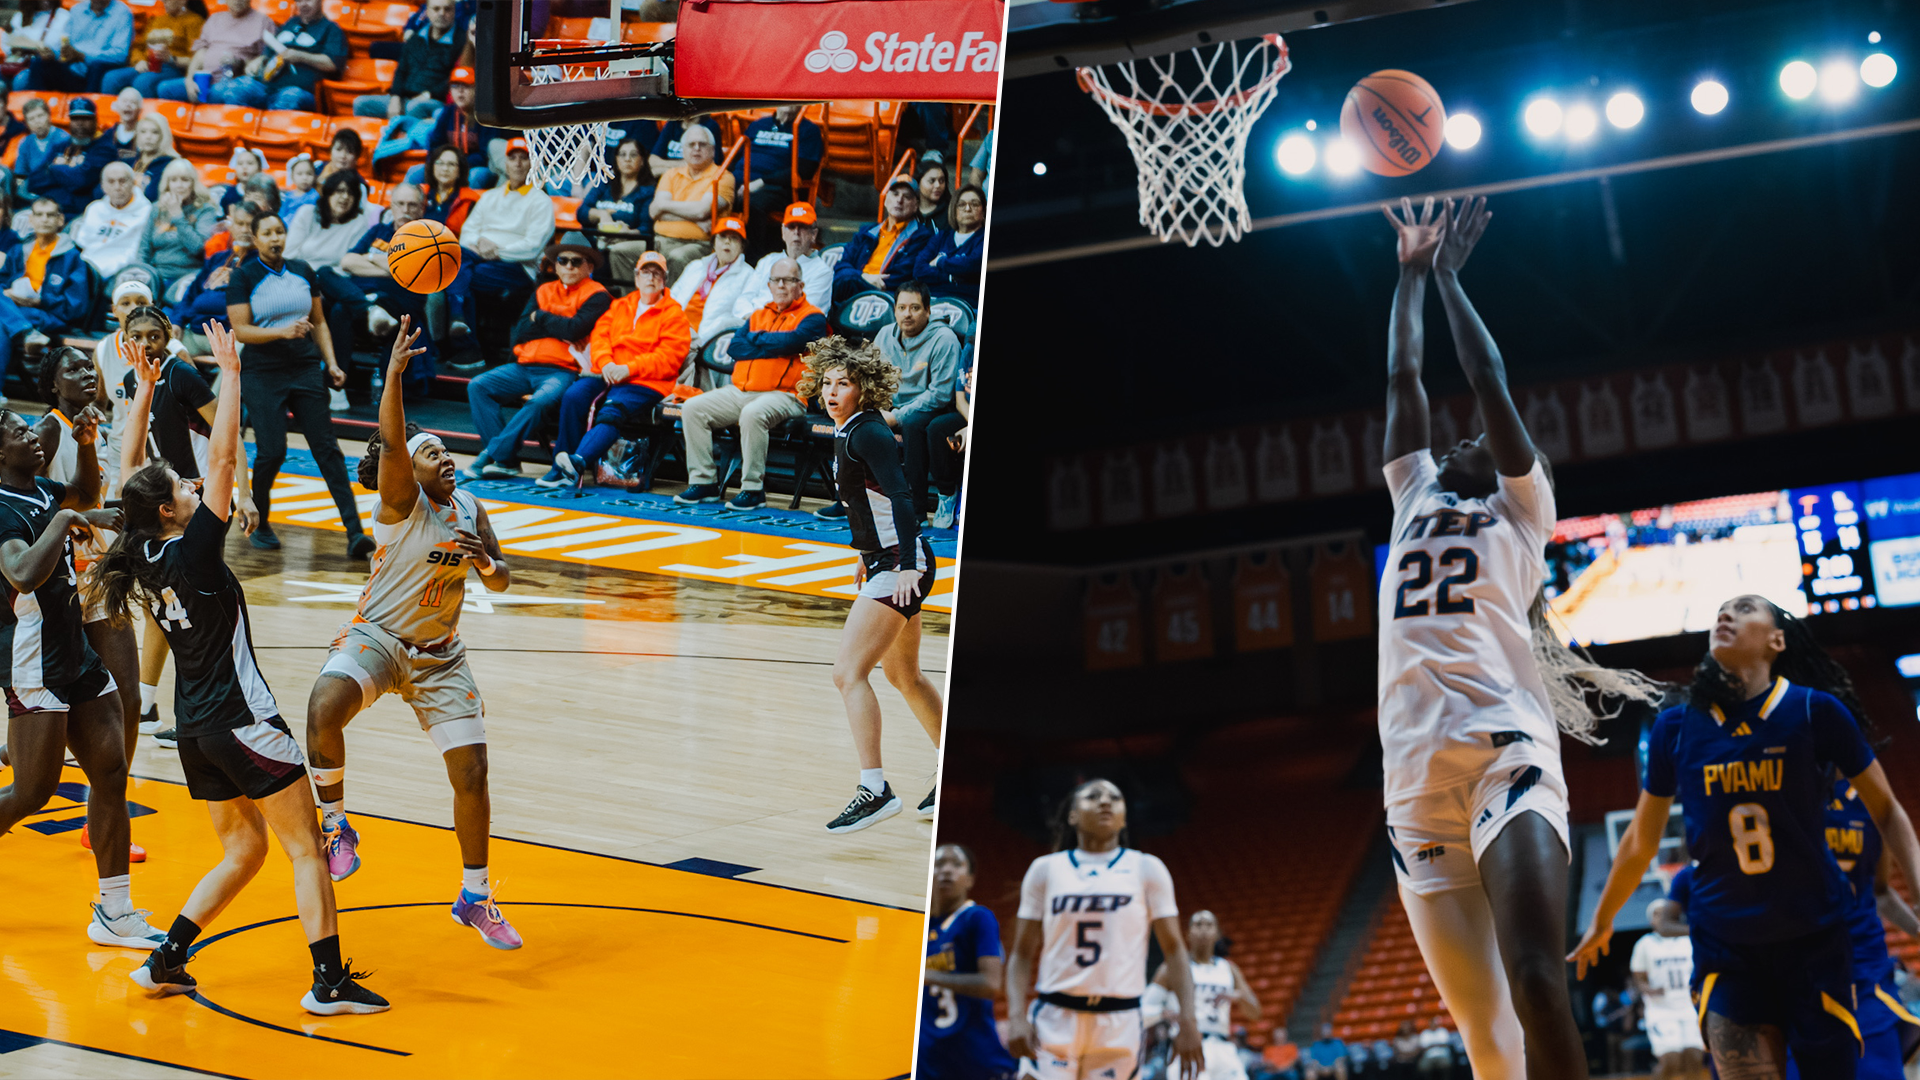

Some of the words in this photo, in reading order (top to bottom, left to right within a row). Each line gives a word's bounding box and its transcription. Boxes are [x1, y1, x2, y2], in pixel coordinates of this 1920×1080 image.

[1371, 106, 1422, 165] Wilson
[1398, 508, 1499, 543] TEP
[426, 551, 464, 567] 915
[419, 578, 446, 607] 11
[1393, 546, 1480, 620] 22
[1247, 601, 1280, 632] 44
[1328, 590, 1355, 622] 14
[1703, 758, 1784, 797] PVAMU
[1417, 845, 1445, 861] 915
[1728, 802, 1776, 876] 8
[1824, 827, 1865, 855] AMU
[1052, 894, 1133, 916] UTEP
[1075, 921, 1103, 968] 5
[929, 985, 959, 1029] 3
